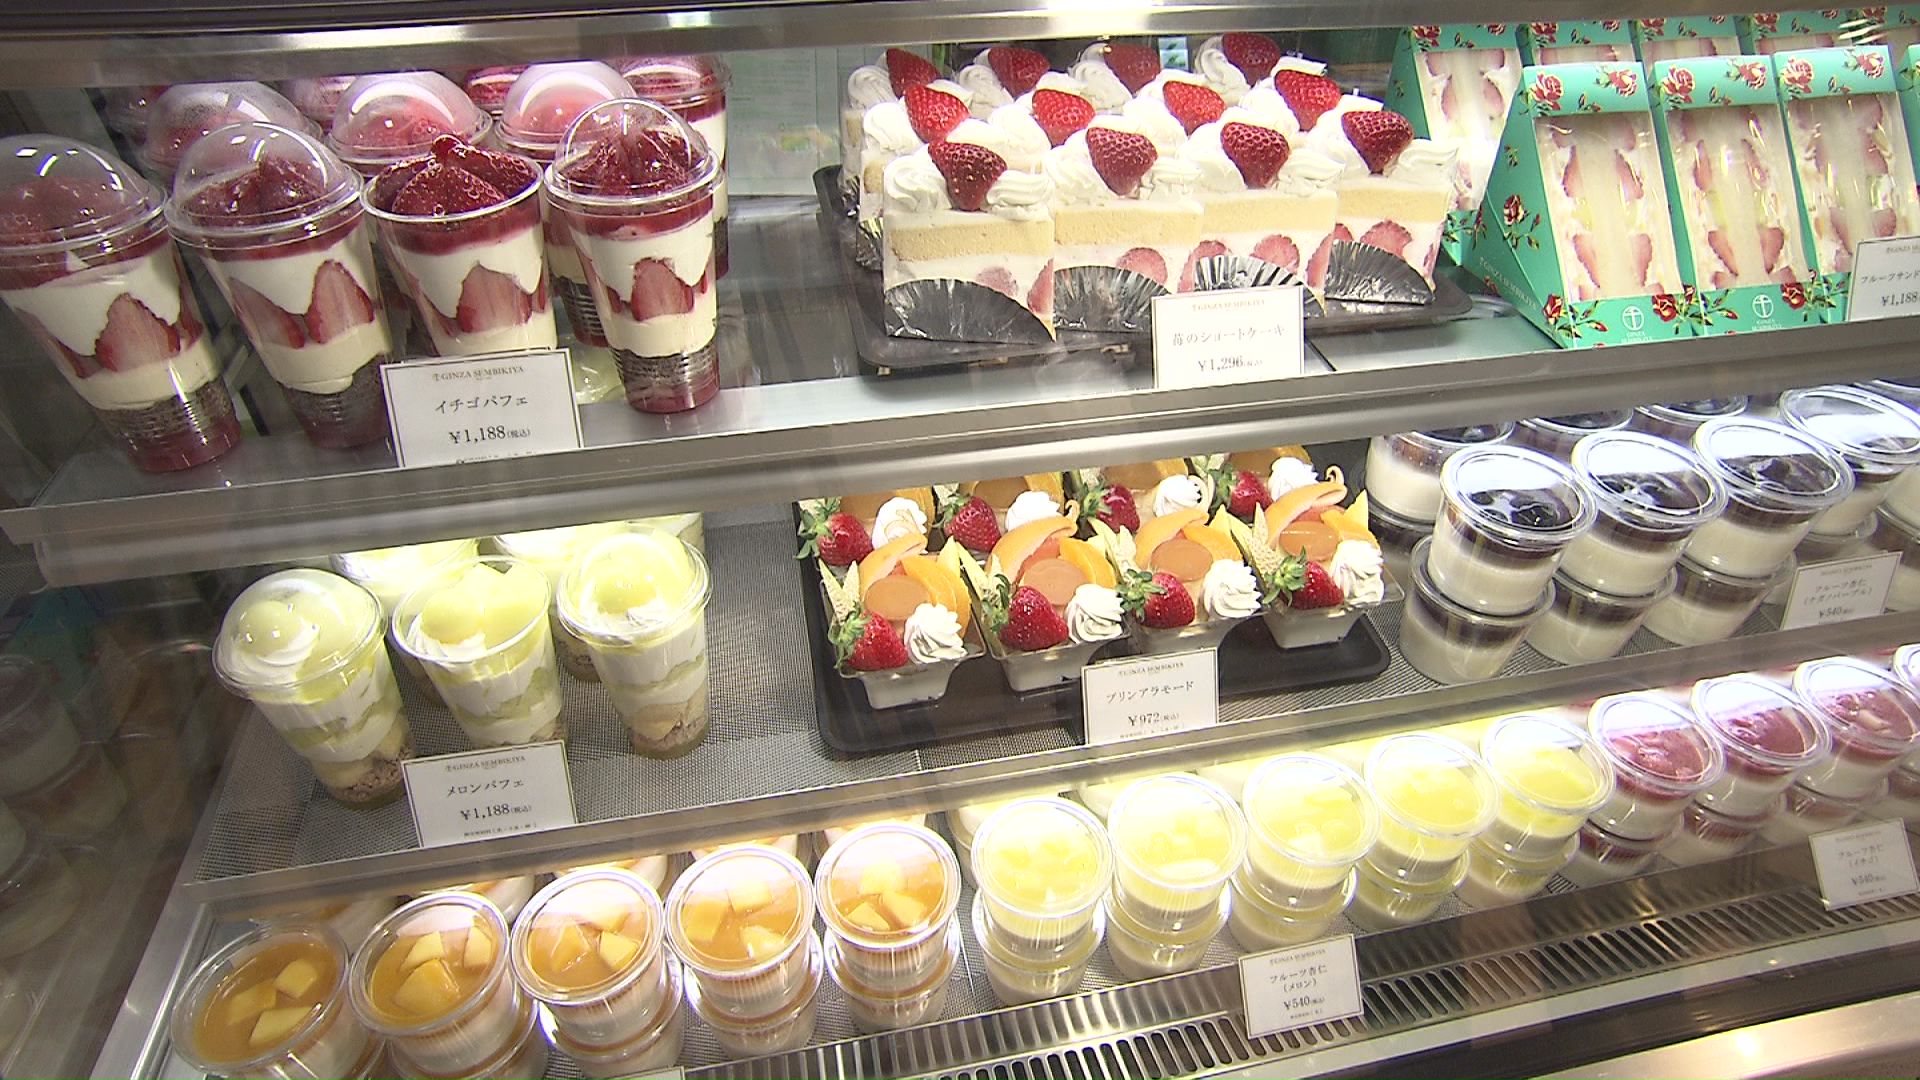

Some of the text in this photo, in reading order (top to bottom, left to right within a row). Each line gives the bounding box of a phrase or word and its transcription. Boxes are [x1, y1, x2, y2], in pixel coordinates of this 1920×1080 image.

[1173, 324, 1285, 346] 苺のショートケーキ
[441, 371, 472, 380] GINZA
[473, 366, 524, 378] SEMBIKIYA
[435, 394, 529, 414] イチゴパフェ
[1106, 681, 1194, 704] プリンアラモード
[447, 779, 524, 796] メロンパフェ
[1270, 964, 1328, 984] フルーツ杏仁
